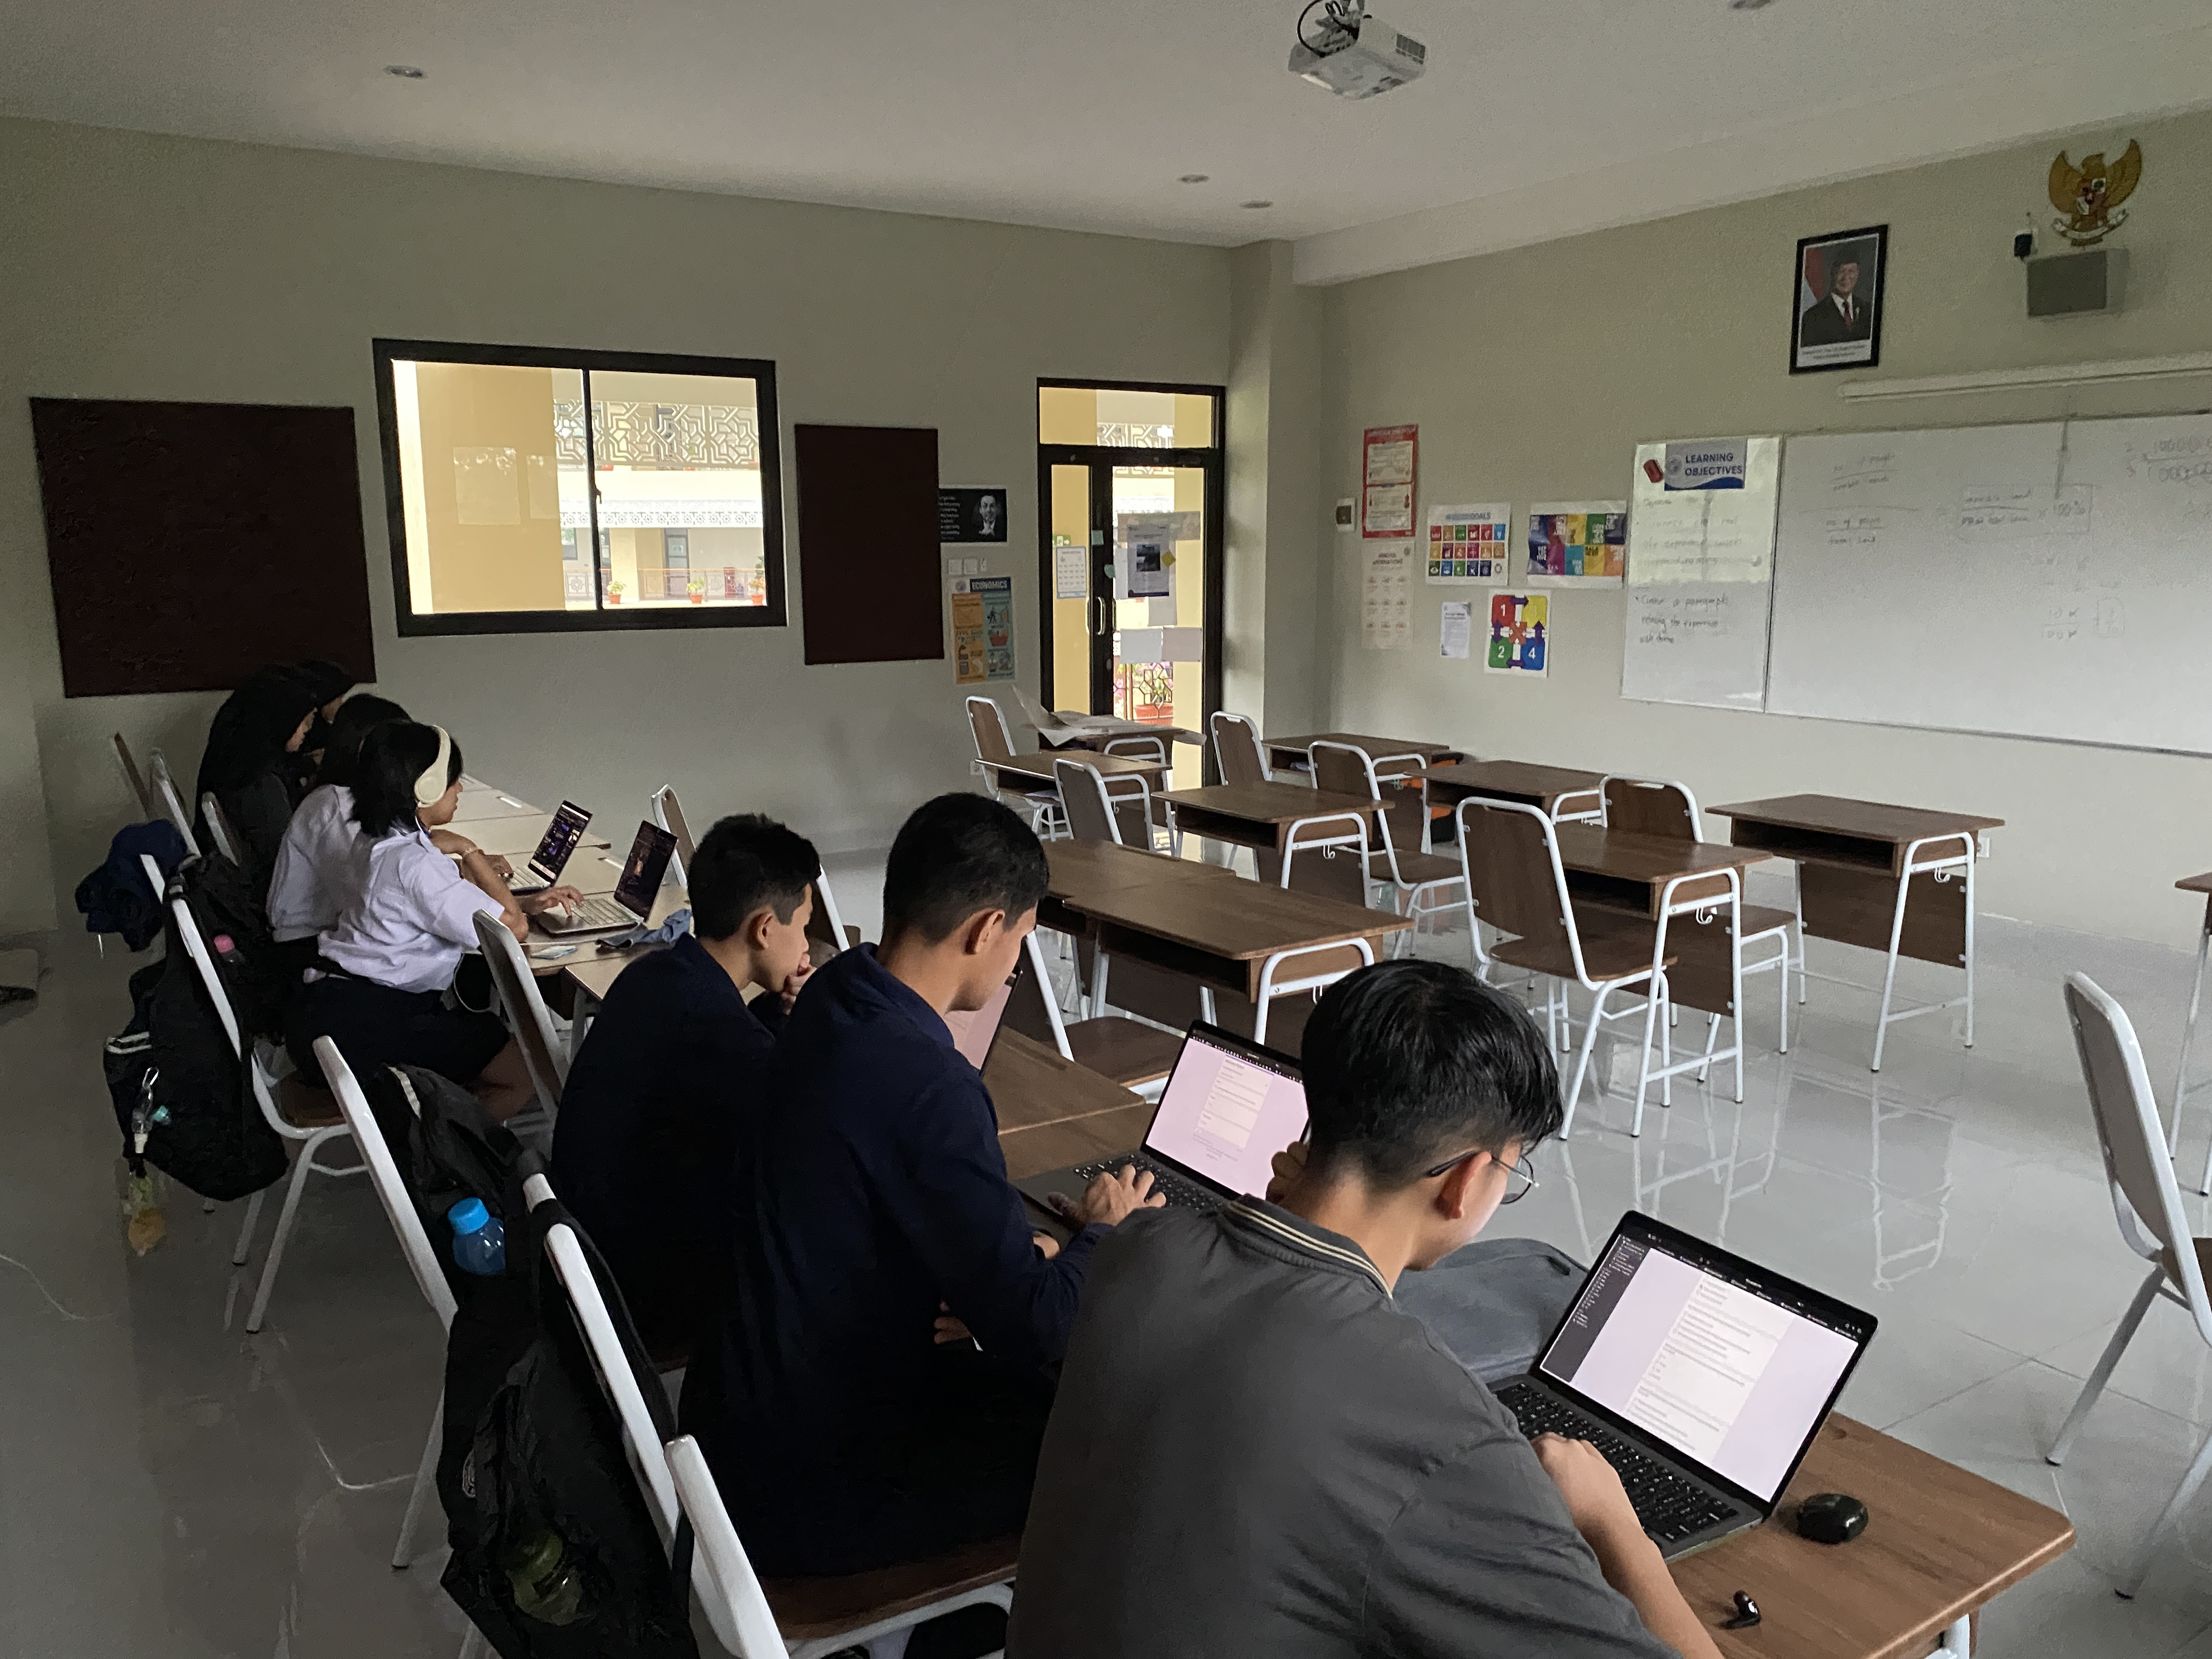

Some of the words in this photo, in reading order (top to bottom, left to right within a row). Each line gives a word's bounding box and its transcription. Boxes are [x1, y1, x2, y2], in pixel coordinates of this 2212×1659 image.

[1685, 452, 1734, 464] LEARNING
[1685, 465, 1742, 476] OBJECTIVES
[972, 580, 1007, 590] ECONOMICS
[1684, 592, 1729, 613] paragraph
[1500, 603, 1505, 616] 1
[1498, 645, 1505, 658] 2
[1528, 647, 1536, 659] 4
